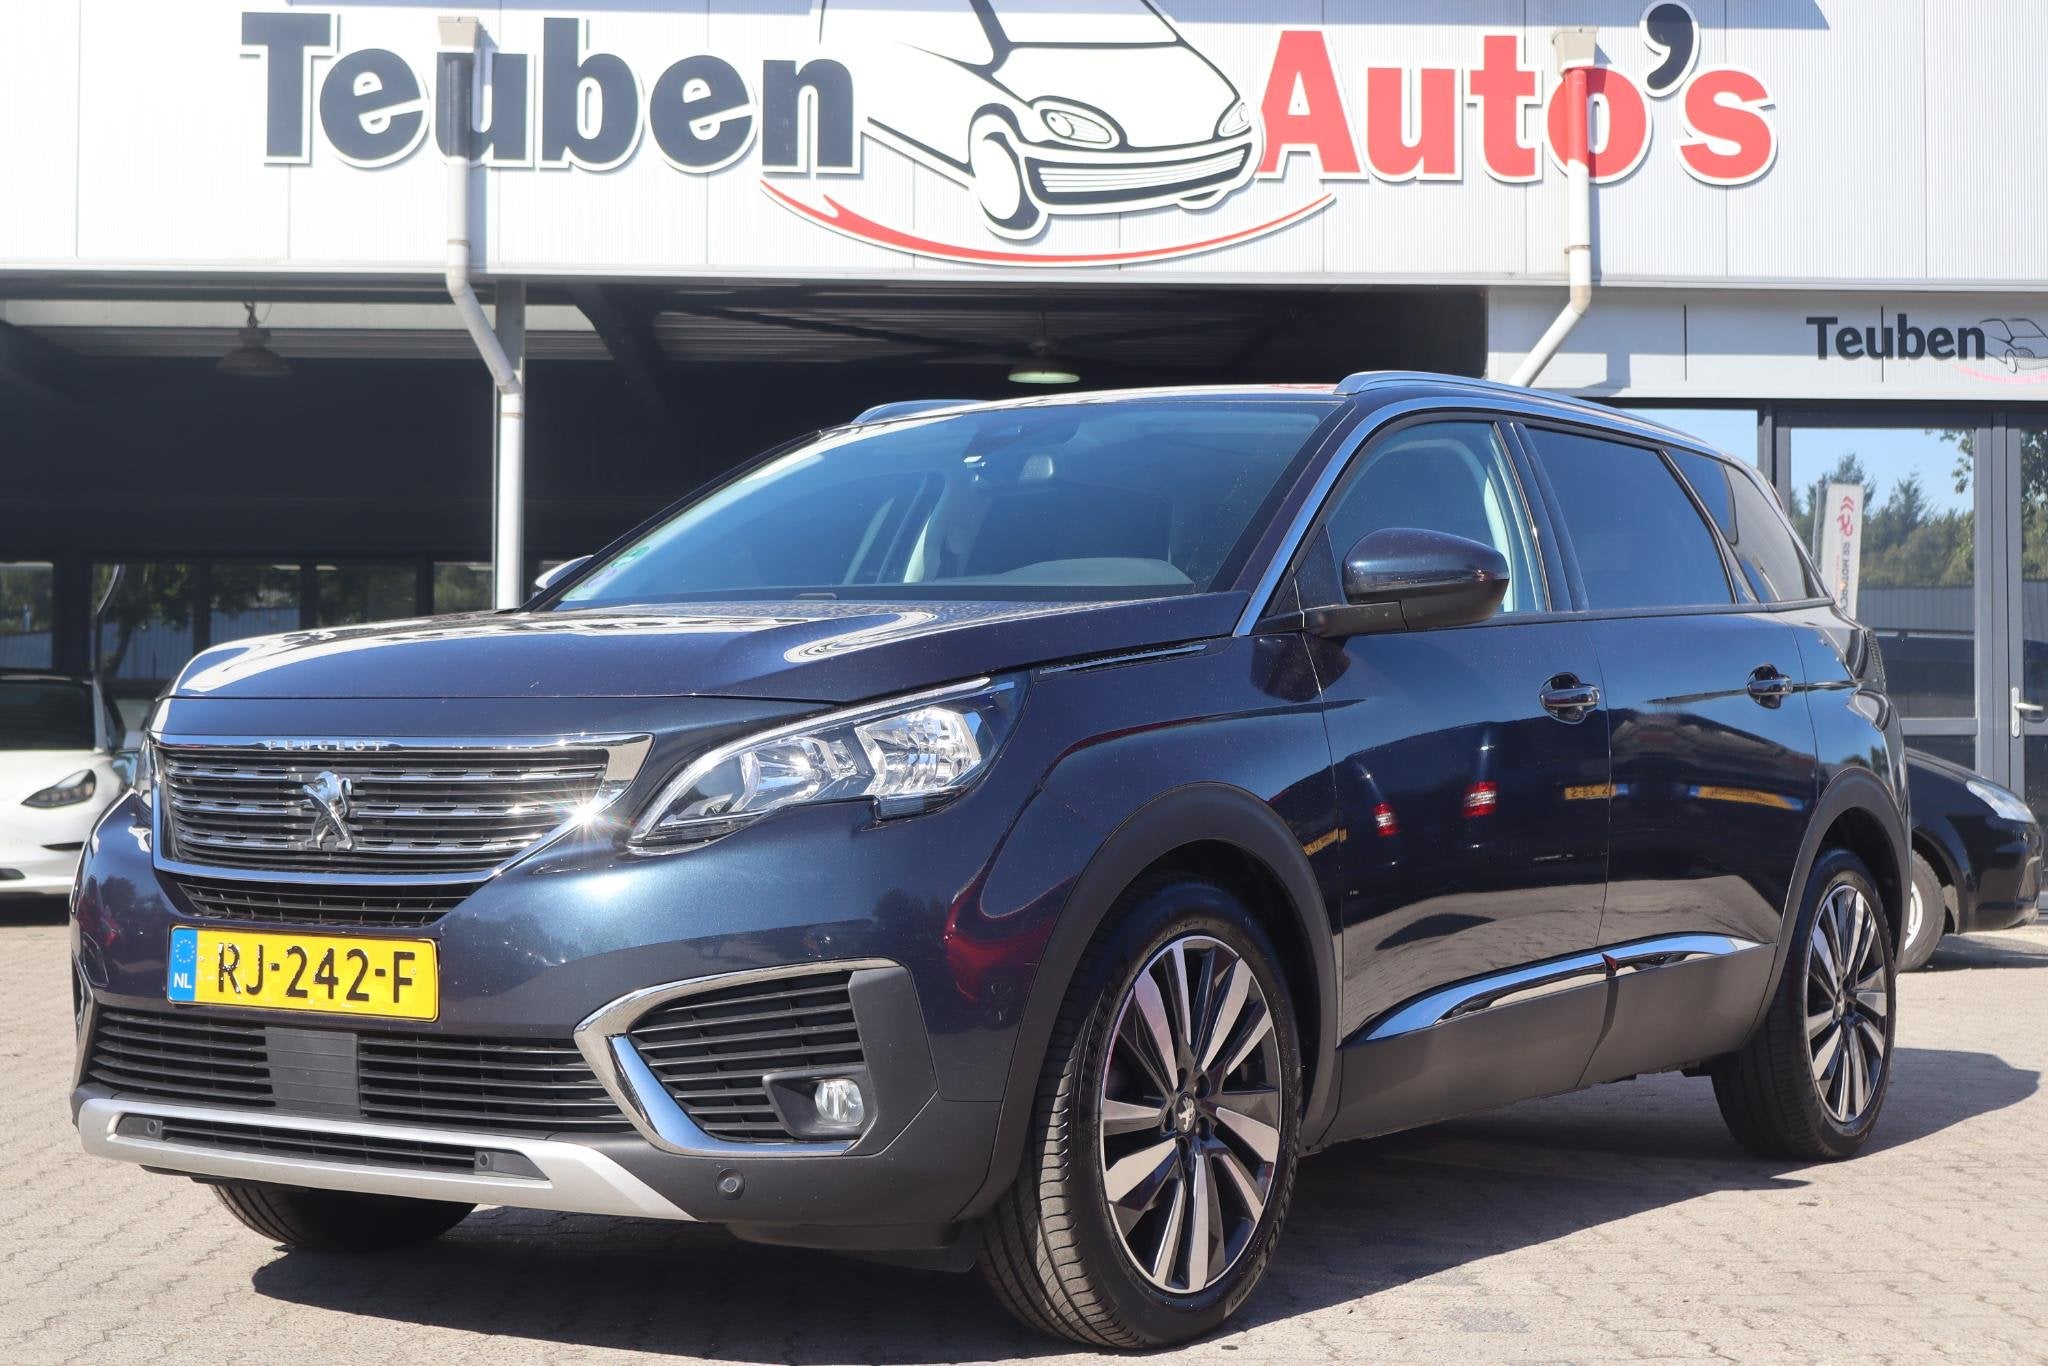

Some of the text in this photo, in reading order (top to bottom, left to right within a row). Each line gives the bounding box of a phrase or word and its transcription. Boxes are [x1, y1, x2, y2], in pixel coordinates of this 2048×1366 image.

[240, 2, 1777, 183] Teuben Auto's
[1805, 313, 1987, 361] Teuben
[268, 739, 384, 751] PEUGEOT
[173, 973, 193, 989] NL
[217, 942, 416, 1004] RJ-242-F
